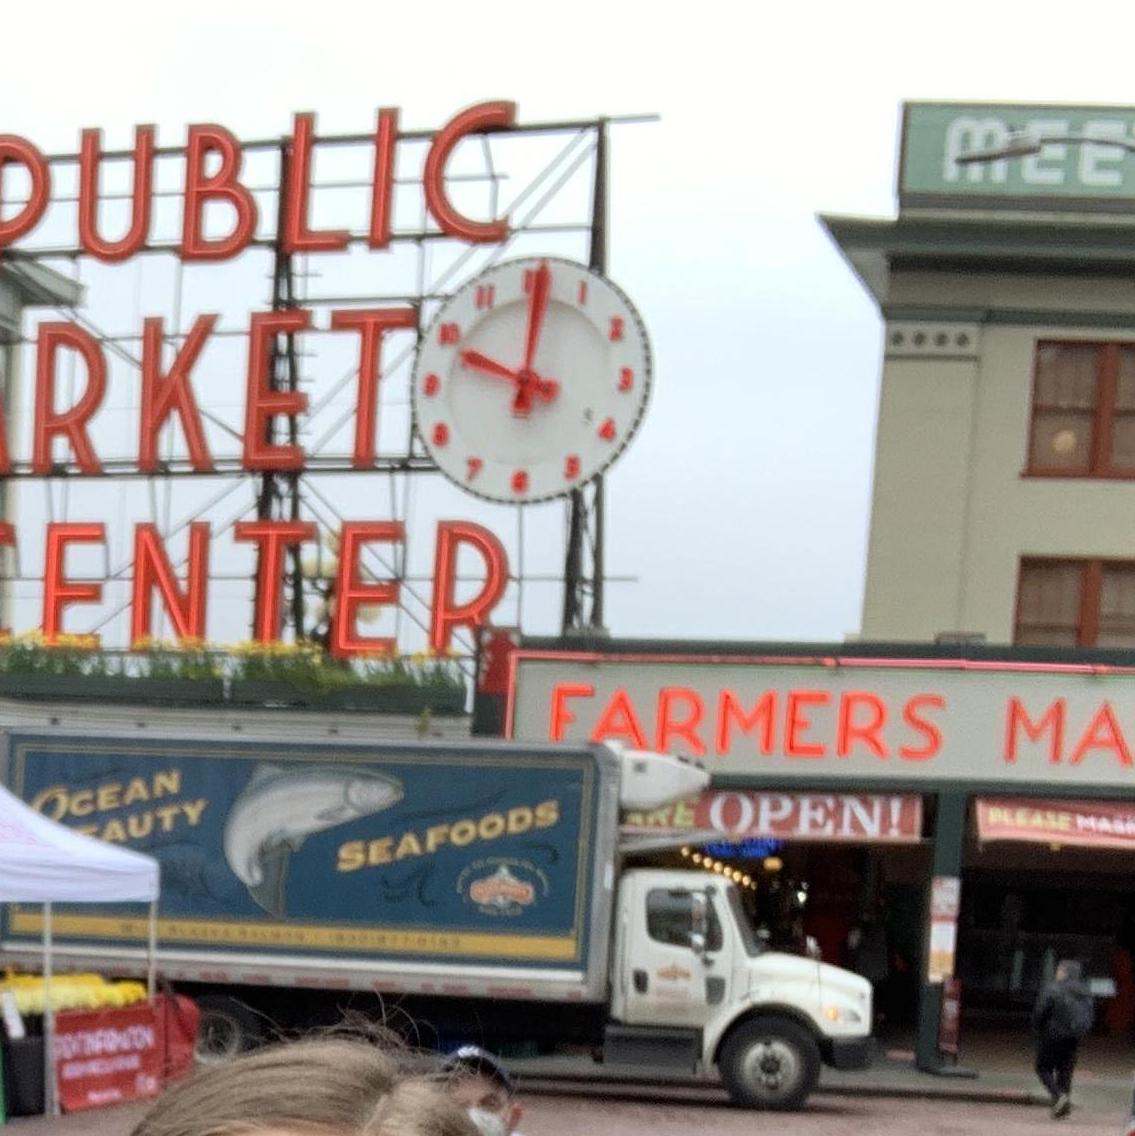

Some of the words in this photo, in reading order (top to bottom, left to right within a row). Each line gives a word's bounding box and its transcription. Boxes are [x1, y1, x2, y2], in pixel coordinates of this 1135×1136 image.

[943, 117, 1135, 186] MEE
[549, 682, 944, 762] FARMERS
[1004, 695, 1133, 766] MA
[31, 768, 182, 825] OCEAN
[710, 792, 901, 838] OPEN!
[335, 799, 561, 874] SEAFOODS
